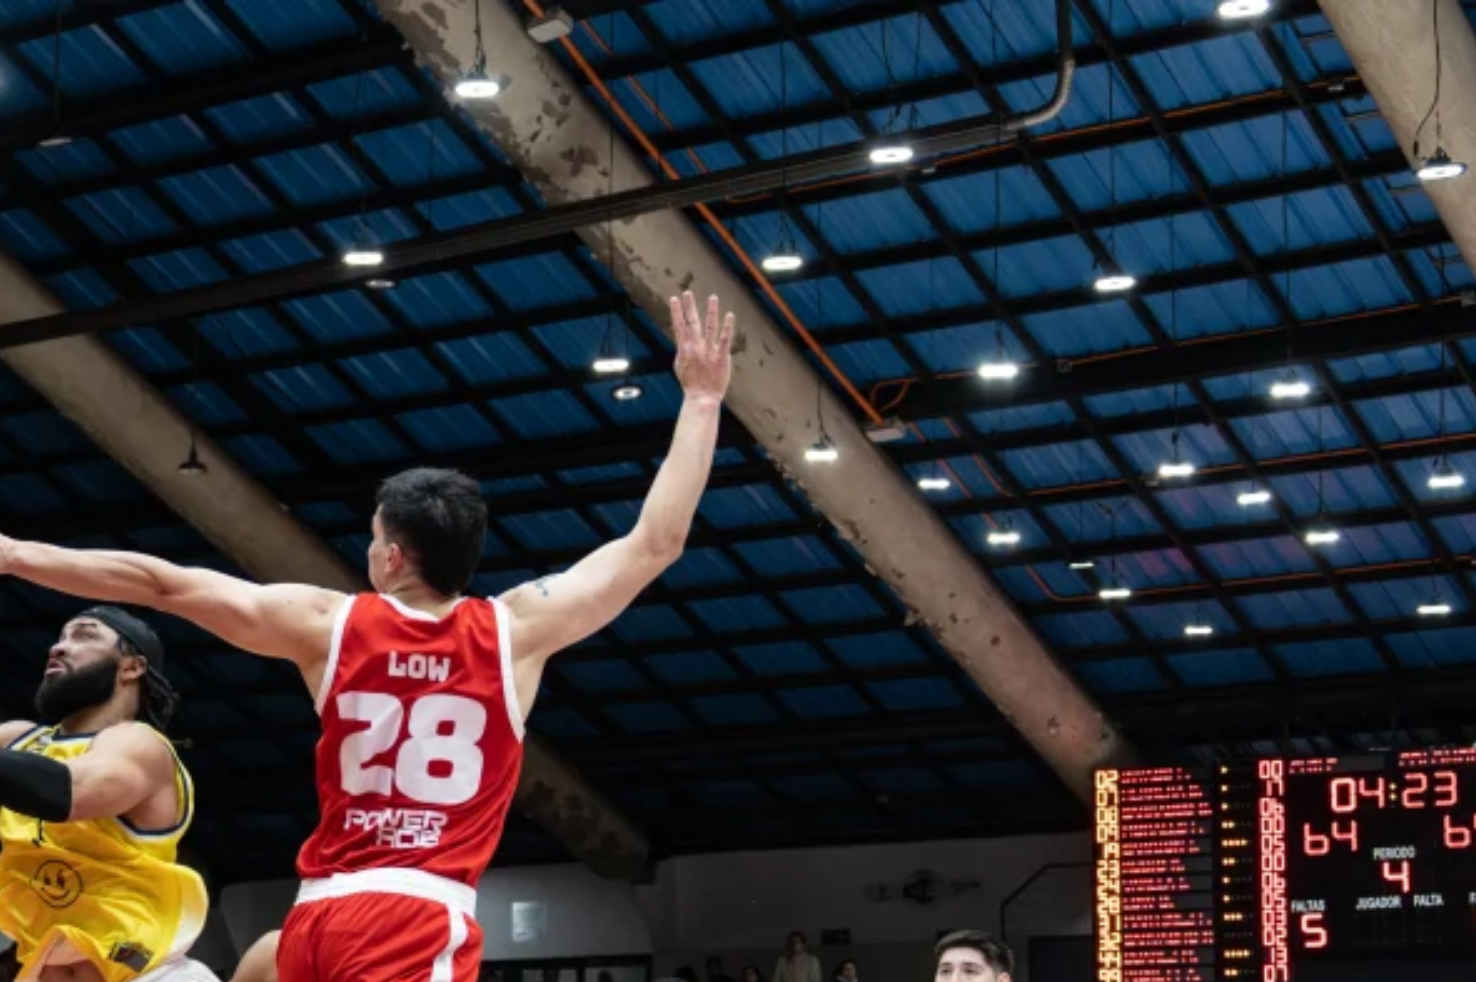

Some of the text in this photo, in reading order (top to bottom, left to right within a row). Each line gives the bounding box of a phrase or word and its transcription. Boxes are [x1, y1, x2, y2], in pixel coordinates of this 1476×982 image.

[388, 651, 451, 682] LOW
[336, 691, 487, 806] 28
[1331, 771, 1458, 813] 04:23
[1303, 820, 1358, 856] 64
[1443, 814, 1476, 849] 6
[1373, 845, 1416, 860] PERIODO
[1382, 861, 1410, 893] 4
[1291, 899, 1326, 914] FALTAS
[1356, 895, 1402, 911] JUGADOR
[1413, 893, 1444, 907] FALTA
[1300, 912, 1328, 948] 5
